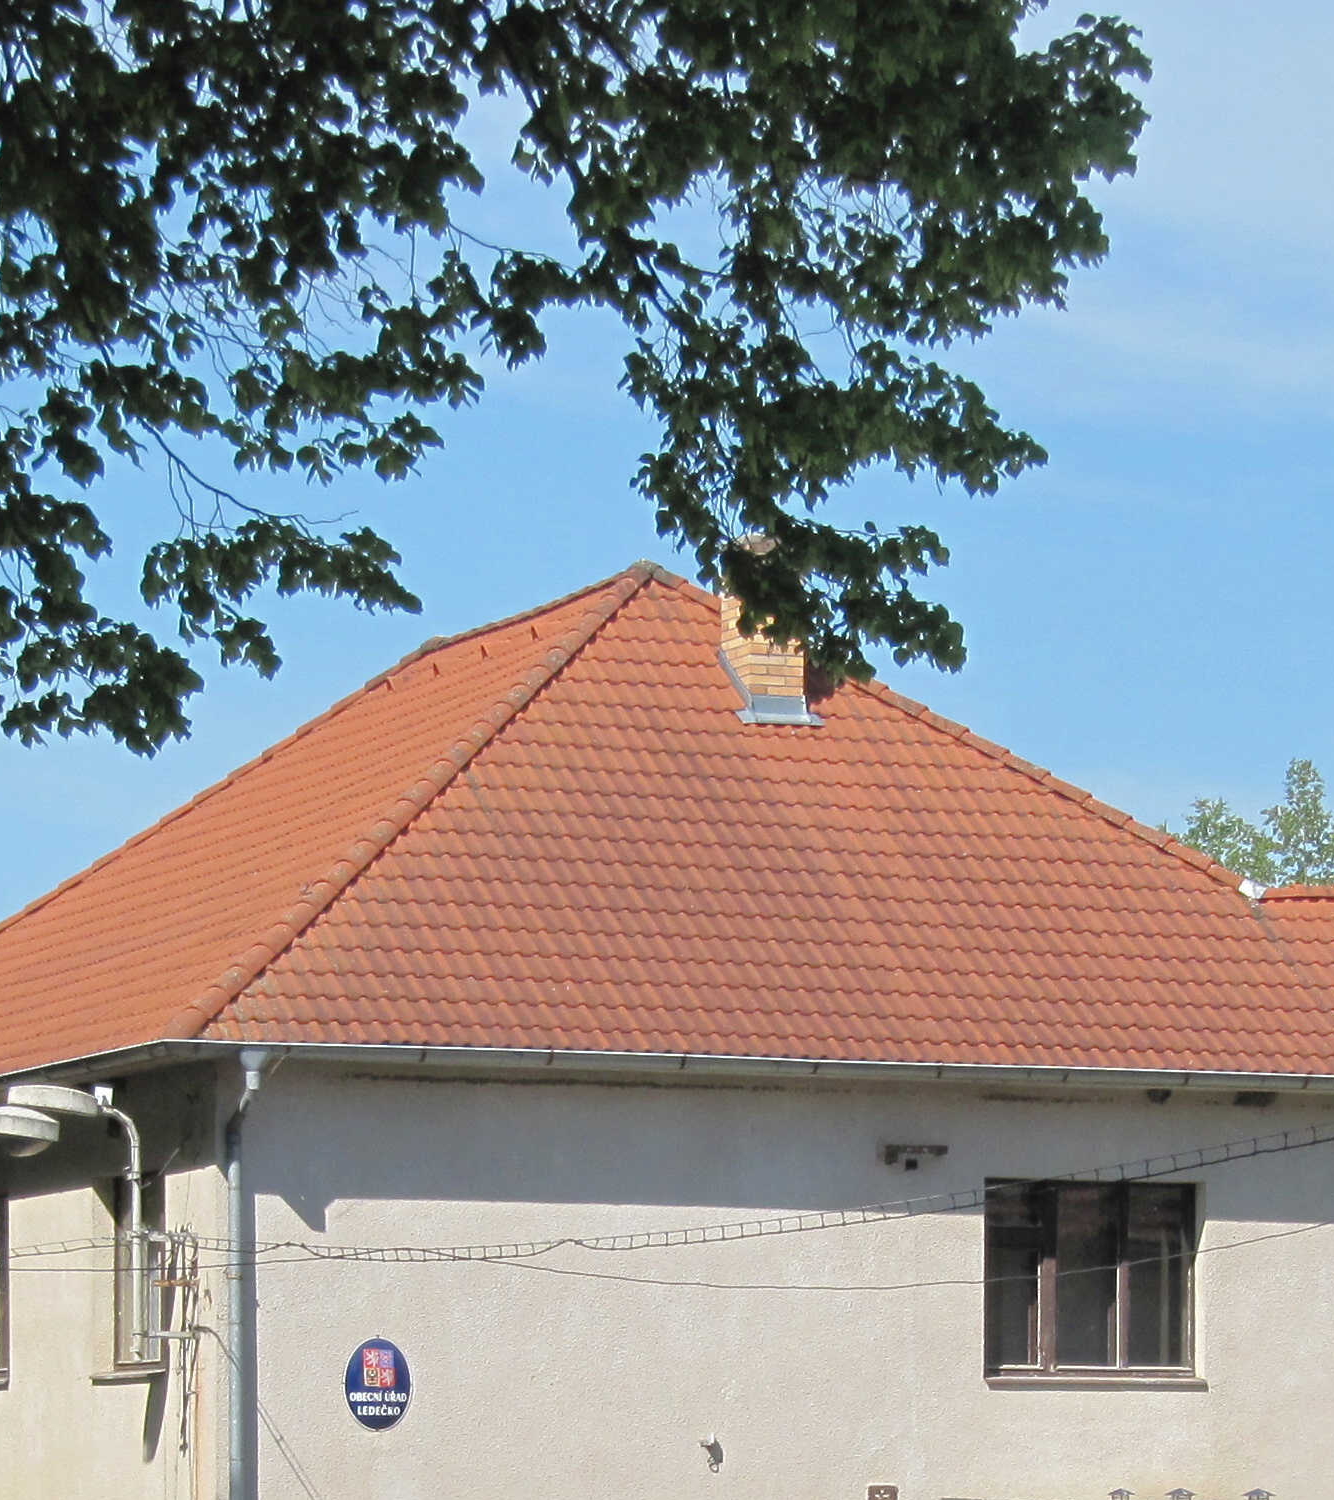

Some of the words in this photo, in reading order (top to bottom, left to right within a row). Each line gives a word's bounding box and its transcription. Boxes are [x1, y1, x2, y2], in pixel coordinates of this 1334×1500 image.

[349, 1391, 382, 1402] OBECNÍ
[384, 1391, 407, 1402] ÚŘAD
[357, 1404, 400, 1416] LEDEČKO
